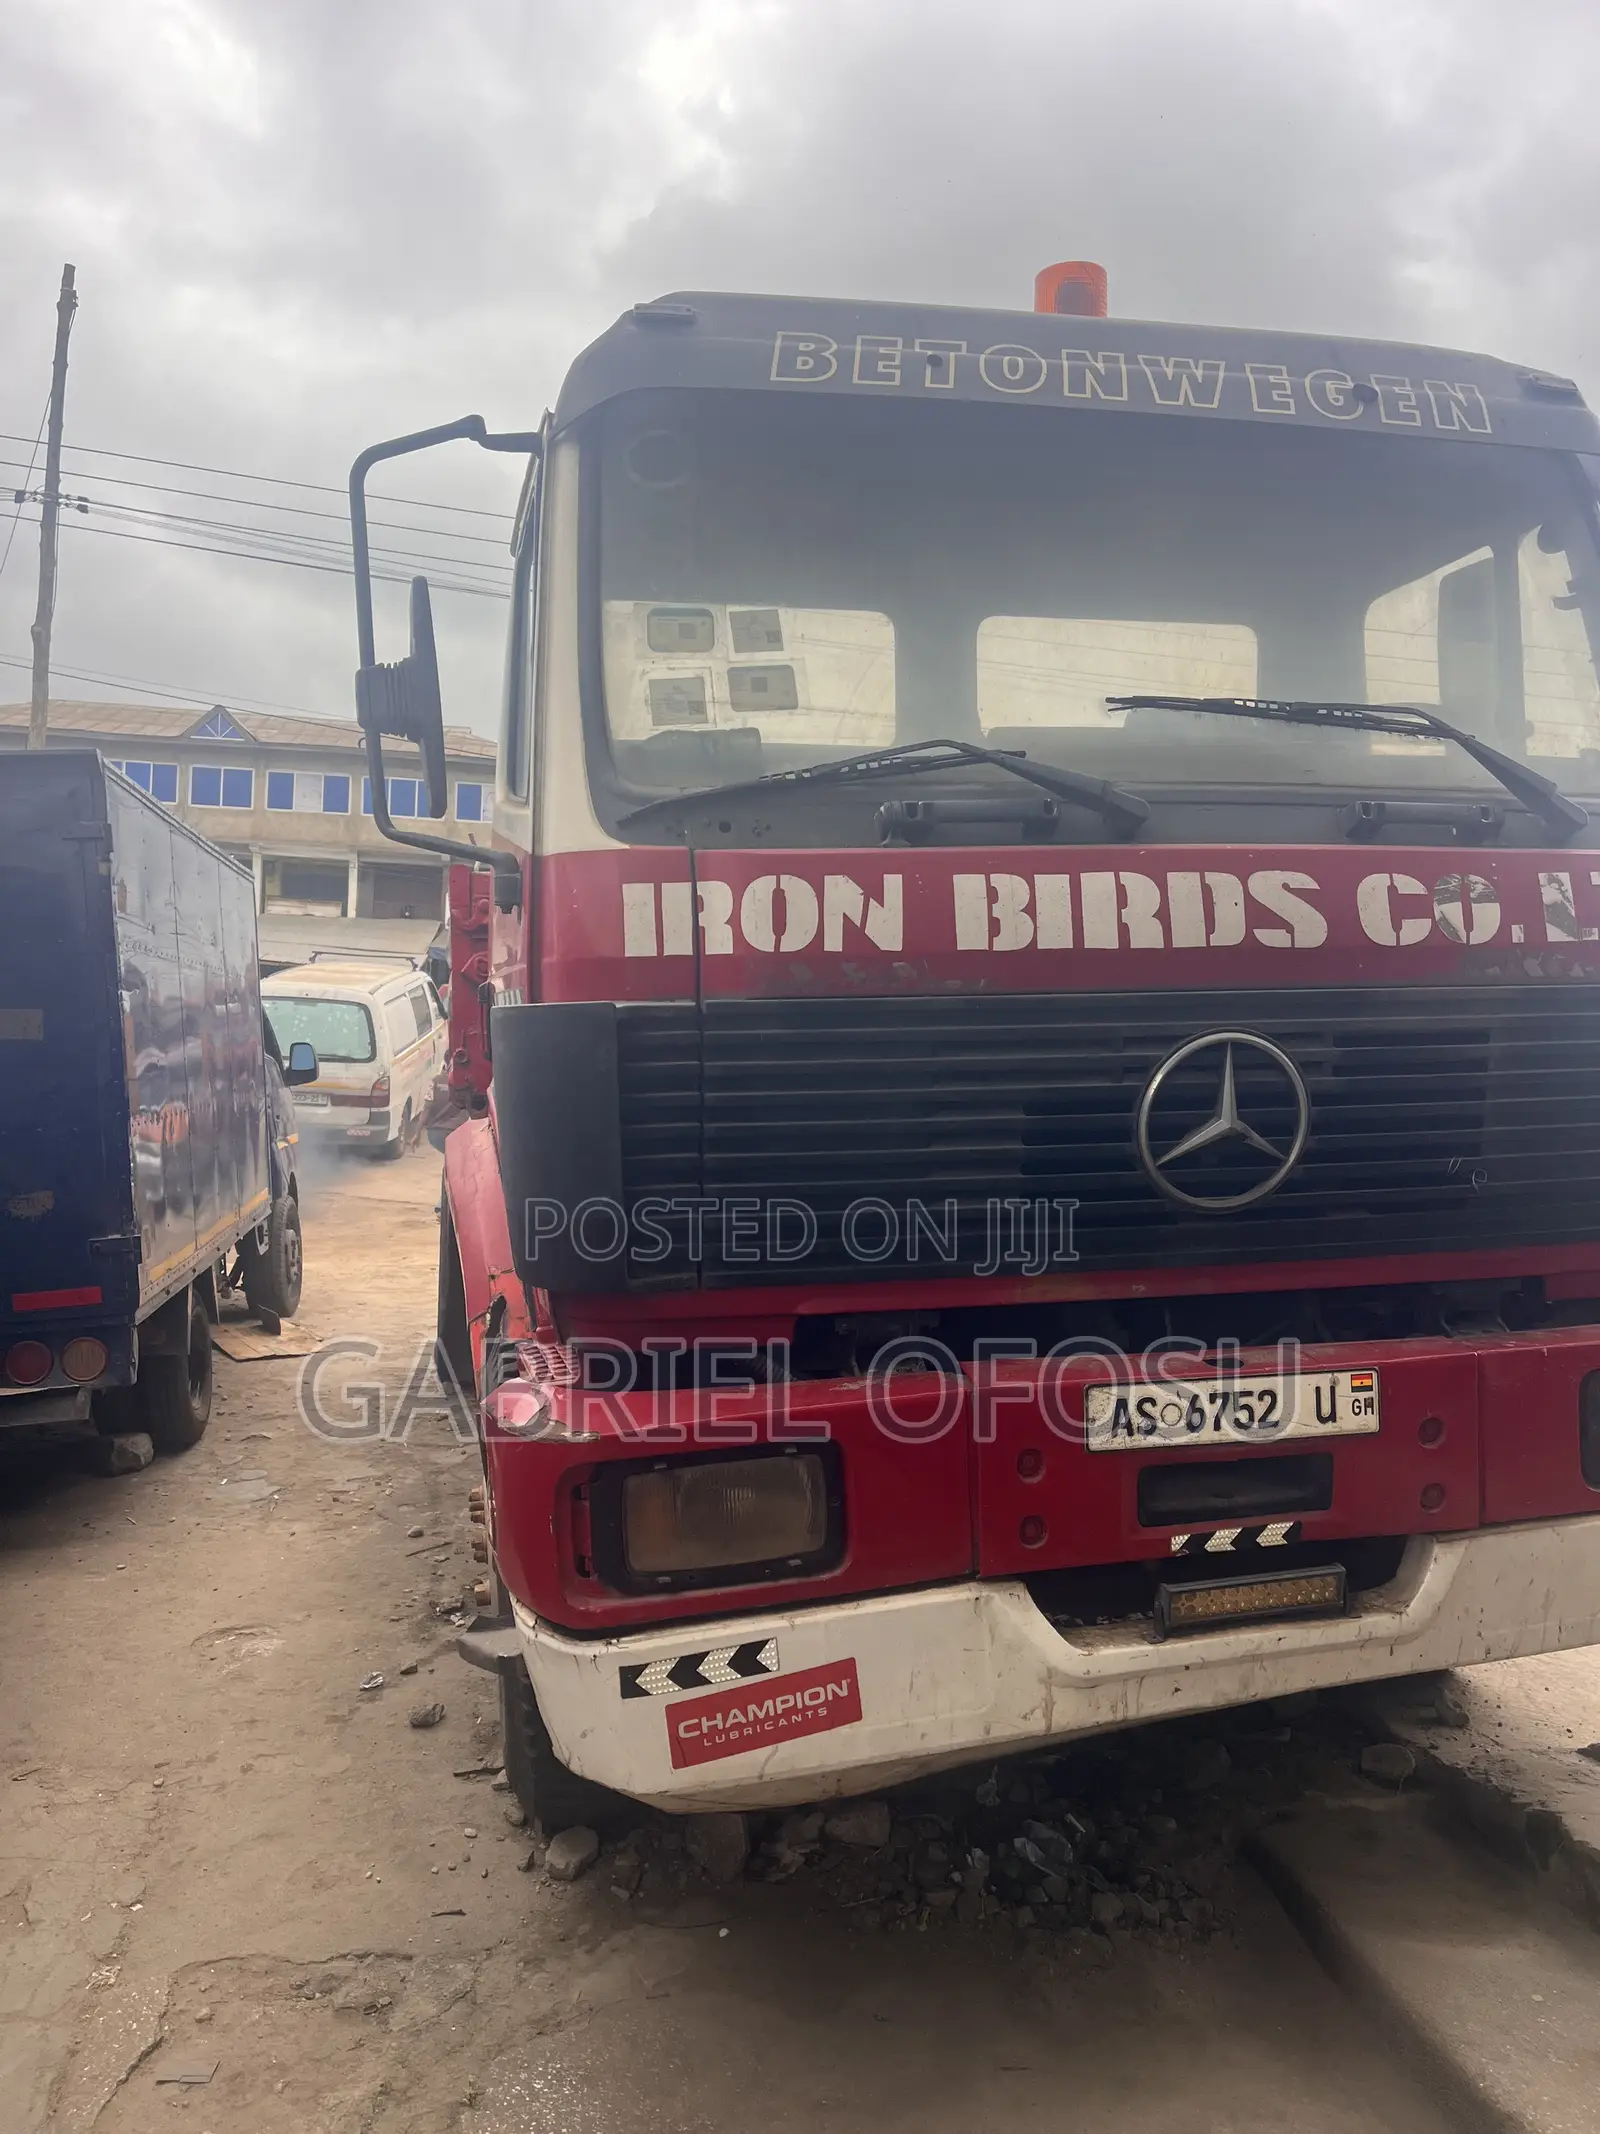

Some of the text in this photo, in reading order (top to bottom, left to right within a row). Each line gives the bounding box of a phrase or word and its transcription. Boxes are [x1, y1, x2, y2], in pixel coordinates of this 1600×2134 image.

[770, 330, 1494, 435] BETONWEGEN
[622, 873, 904, 957] IRON
[952, 870, 1328, 951] BIRDS
[1111, 1385, 1337, 1438] AS 6752 U
[1351, 1396, 1375, 1417] GH
[678, 1679, 849, 1739] CHAMPION
[703, 1706, 829, 1747] LUBRICANTS
